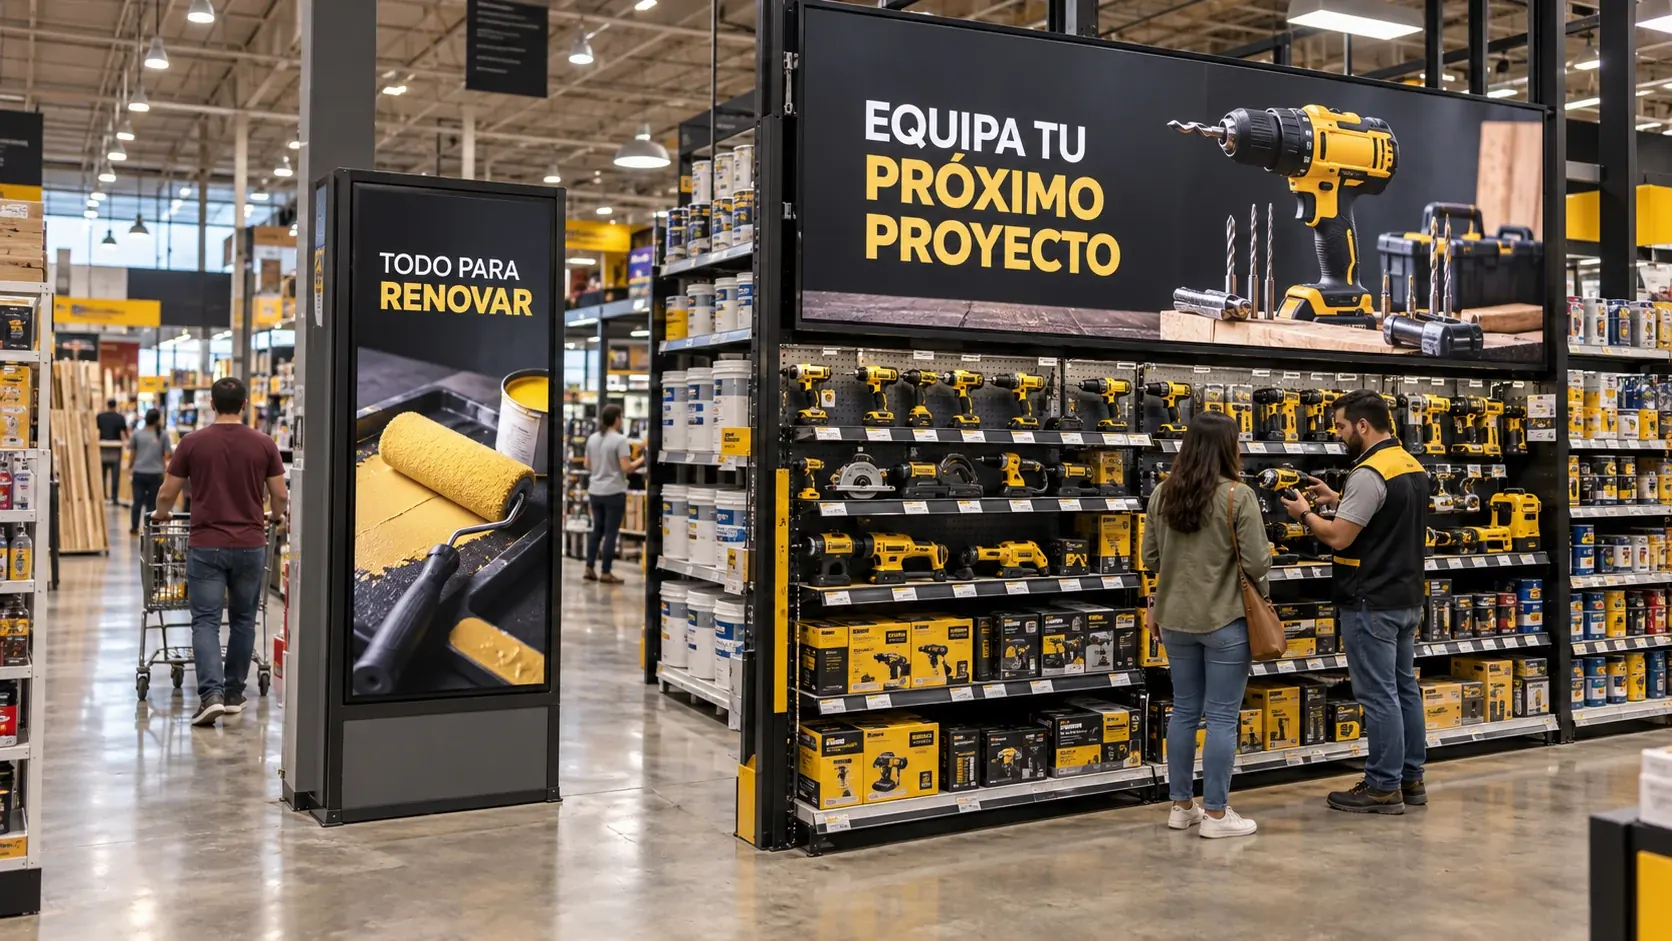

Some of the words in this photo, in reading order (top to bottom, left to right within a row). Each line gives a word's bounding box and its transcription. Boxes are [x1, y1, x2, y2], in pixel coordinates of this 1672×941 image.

[865, 99, 1026, 157] EQUIPA
[1033, 120, 1086, 163] TU
[865, 152, 1104, 221] PRÓXIMO
[379, 252, 452, 277] TODO
[458, 256, 520, 281] PARA
[865, 213, 1121, 277] PROYECTO
[380, 281, 533, 316] RENOVAR
